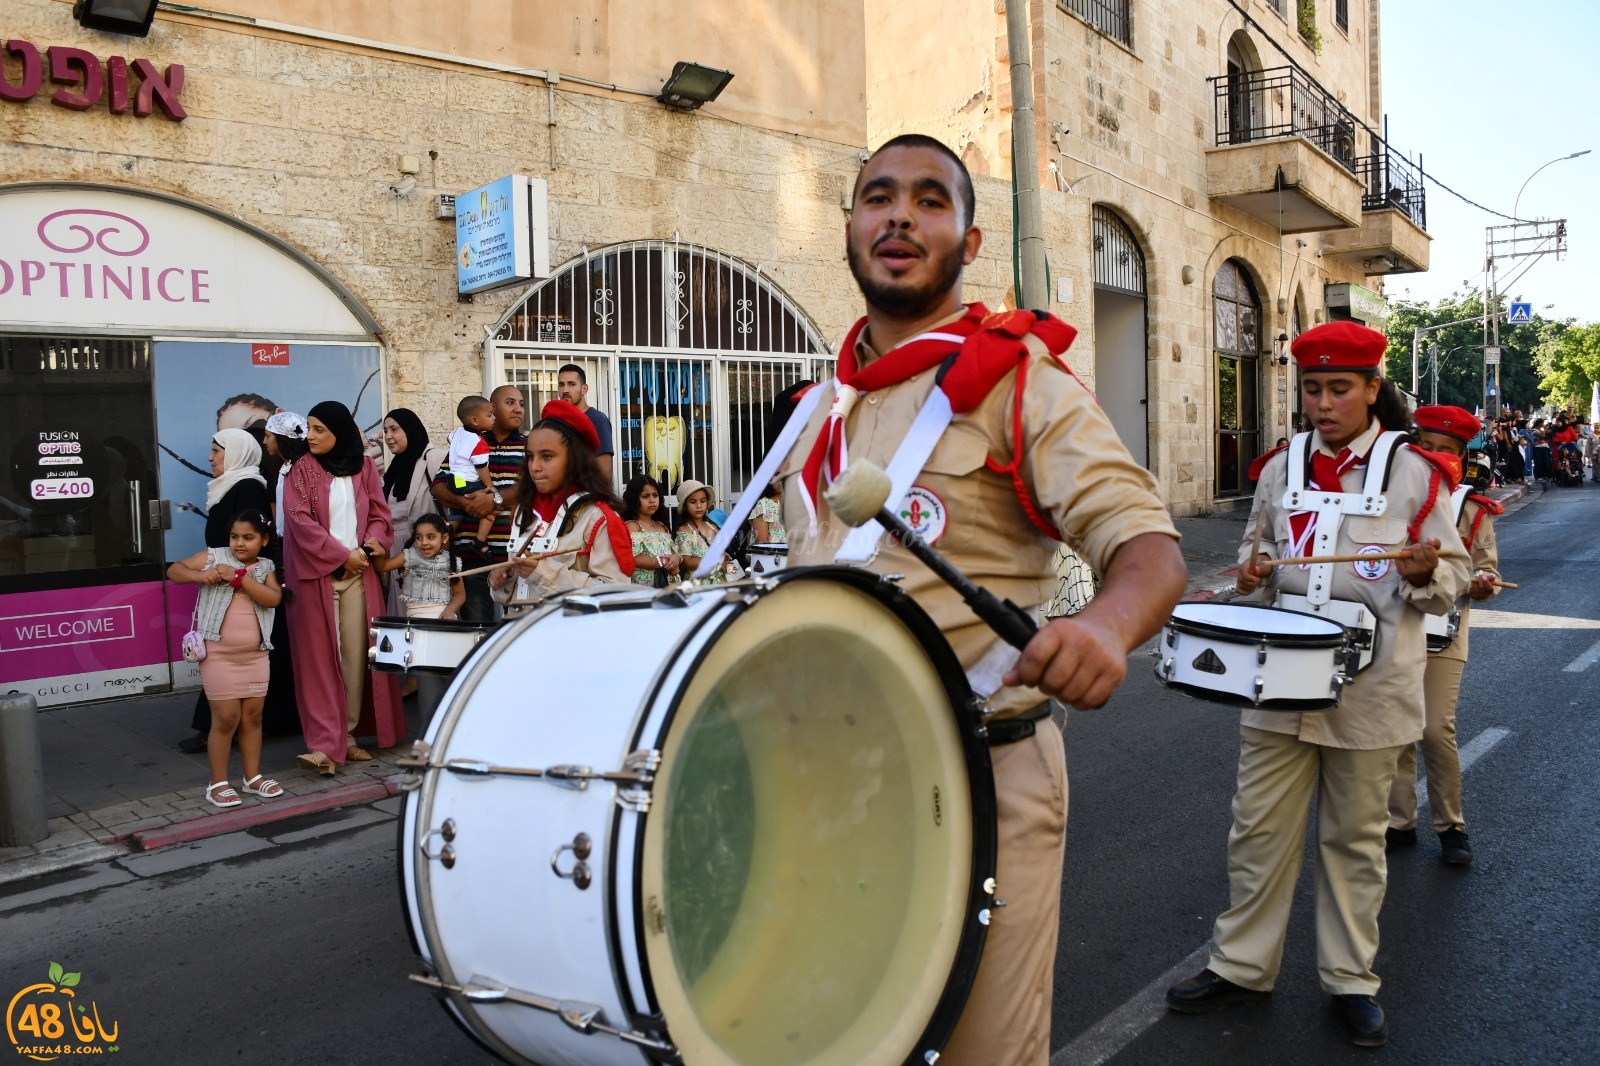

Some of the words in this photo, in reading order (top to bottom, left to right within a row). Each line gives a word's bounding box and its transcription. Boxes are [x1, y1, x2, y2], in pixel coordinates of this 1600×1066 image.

[254, 345, 287, 362] Ray-Ban
[39, 430, 79, 441] FUSION
[38, 442, 81, 454] OPTIC
[46, 470, 58, 479] نظر
[58, 470, 79, 478] نظارات
[15, 617, 115, 641] WELCOME
[38, 683, 90, 697] GUCCI
